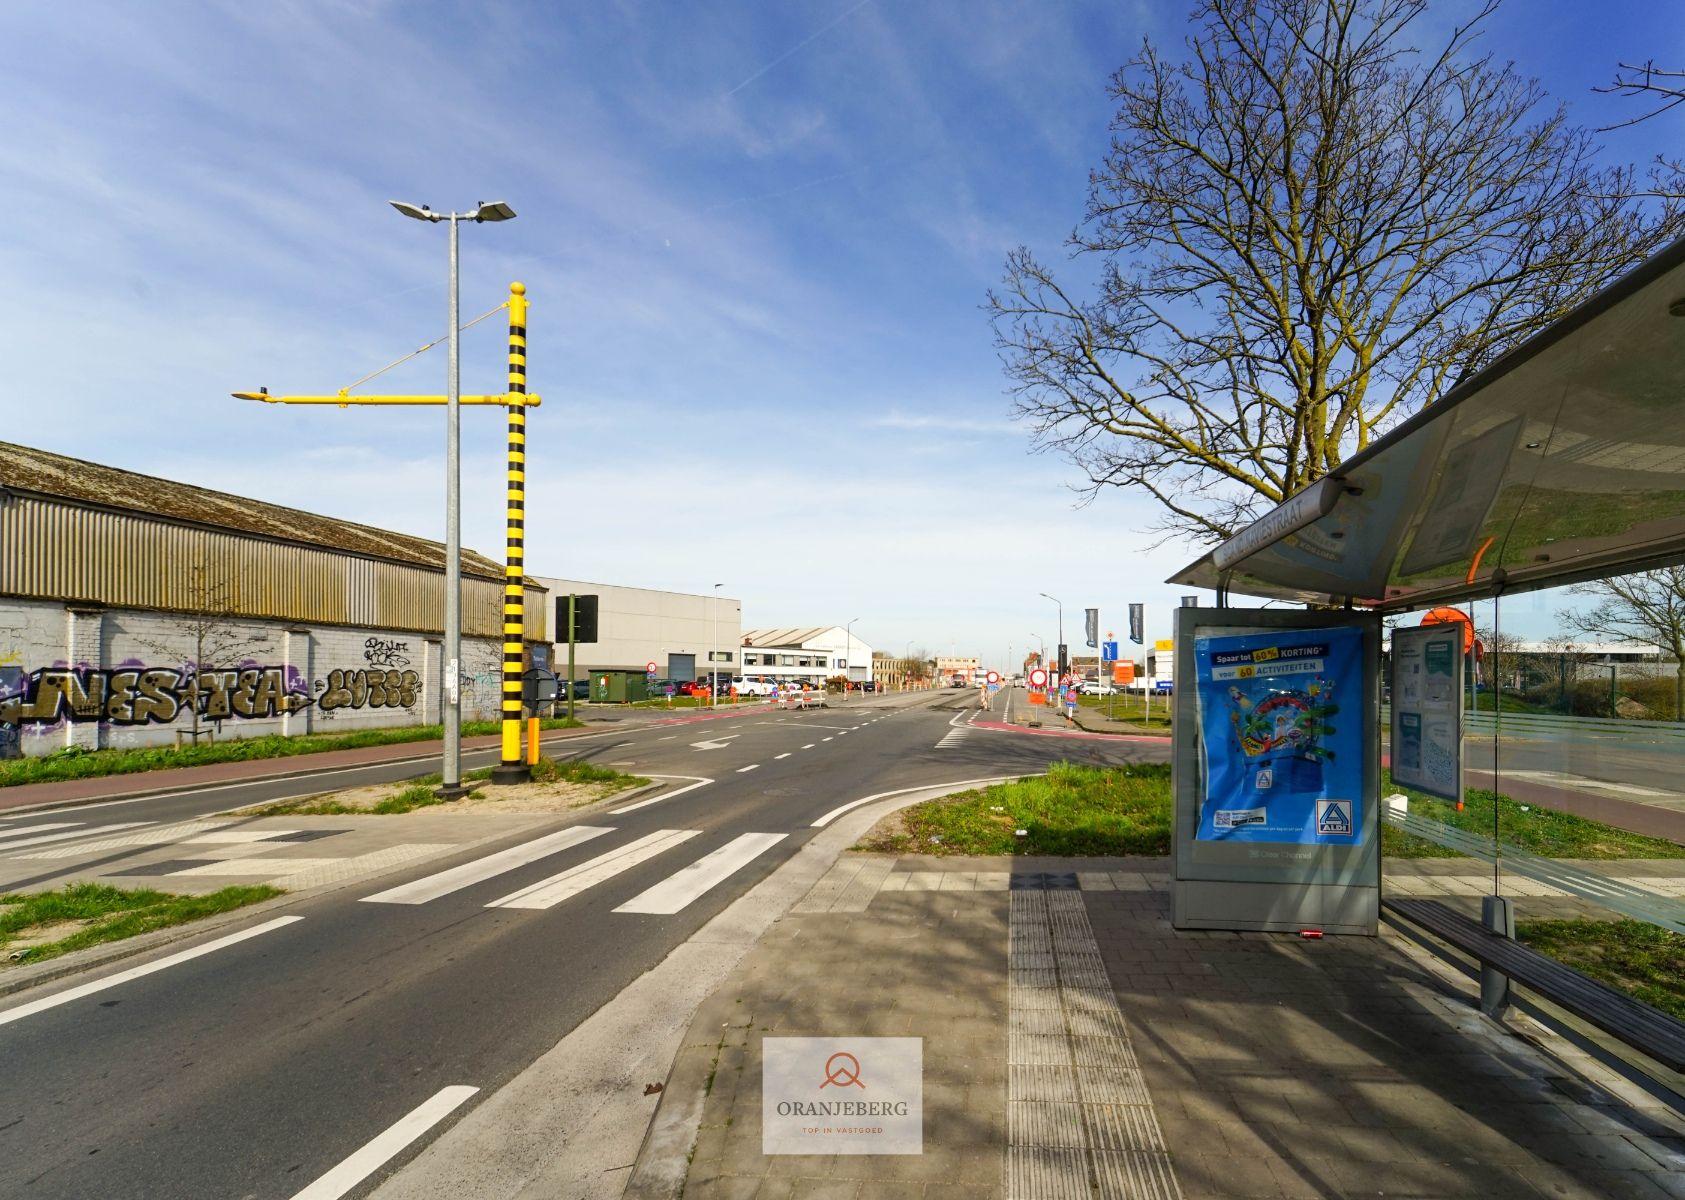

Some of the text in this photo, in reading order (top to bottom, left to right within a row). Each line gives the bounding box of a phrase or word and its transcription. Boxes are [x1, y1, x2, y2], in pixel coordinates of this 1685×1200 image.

[1216, 655, 1239, 664] Spaar
[1240, 654, 1251, 662] tot
[1255, 649, 1278, 661] 60%
[1240, 667, 1252, 678] 60
[1257, 663, 1316, 675] ACTIVITEITEN
